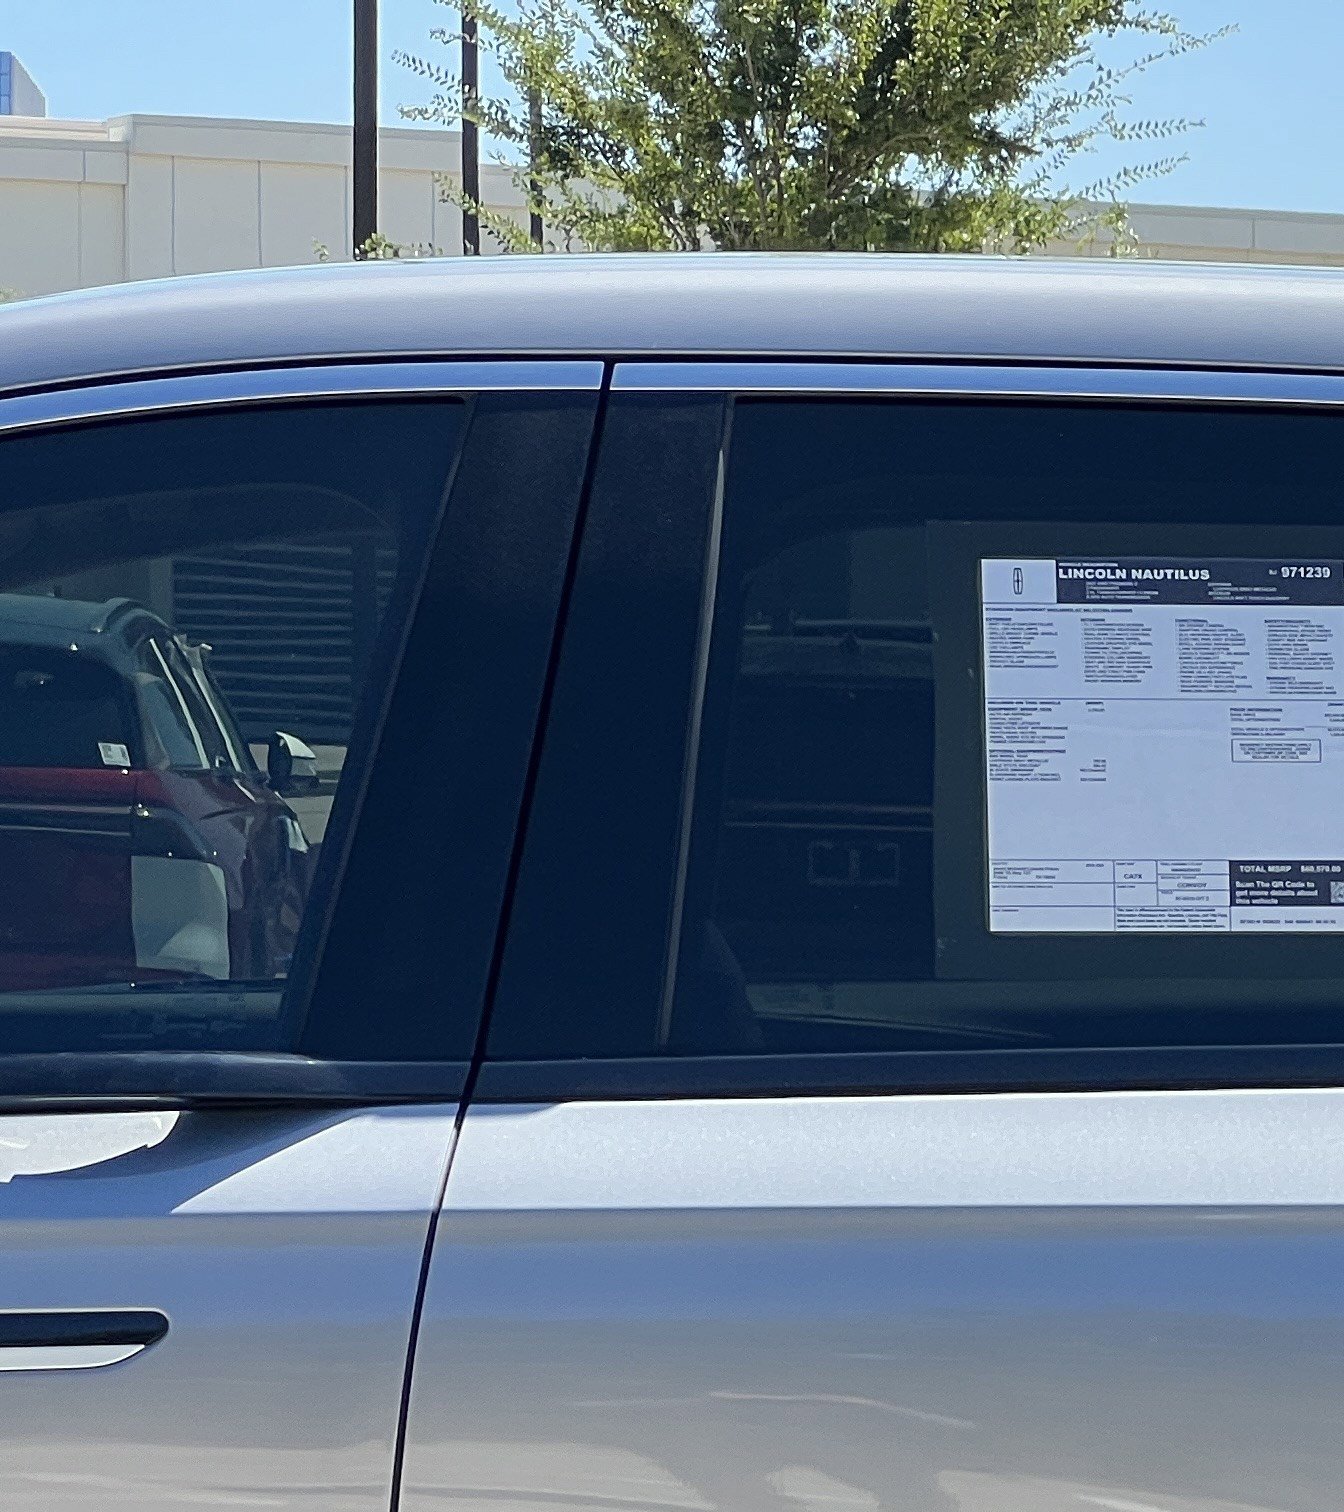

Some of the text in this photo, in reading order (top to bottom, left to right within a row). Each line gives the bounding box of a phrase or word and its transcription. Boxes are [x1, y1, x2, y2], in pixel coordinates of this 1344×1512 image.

[1058, 567, 1210, 580] LINCOLN NAUTILUS
[1281, 567, 1331, 578] 971239
[1239, 865, 1267, 873] TOTAL
